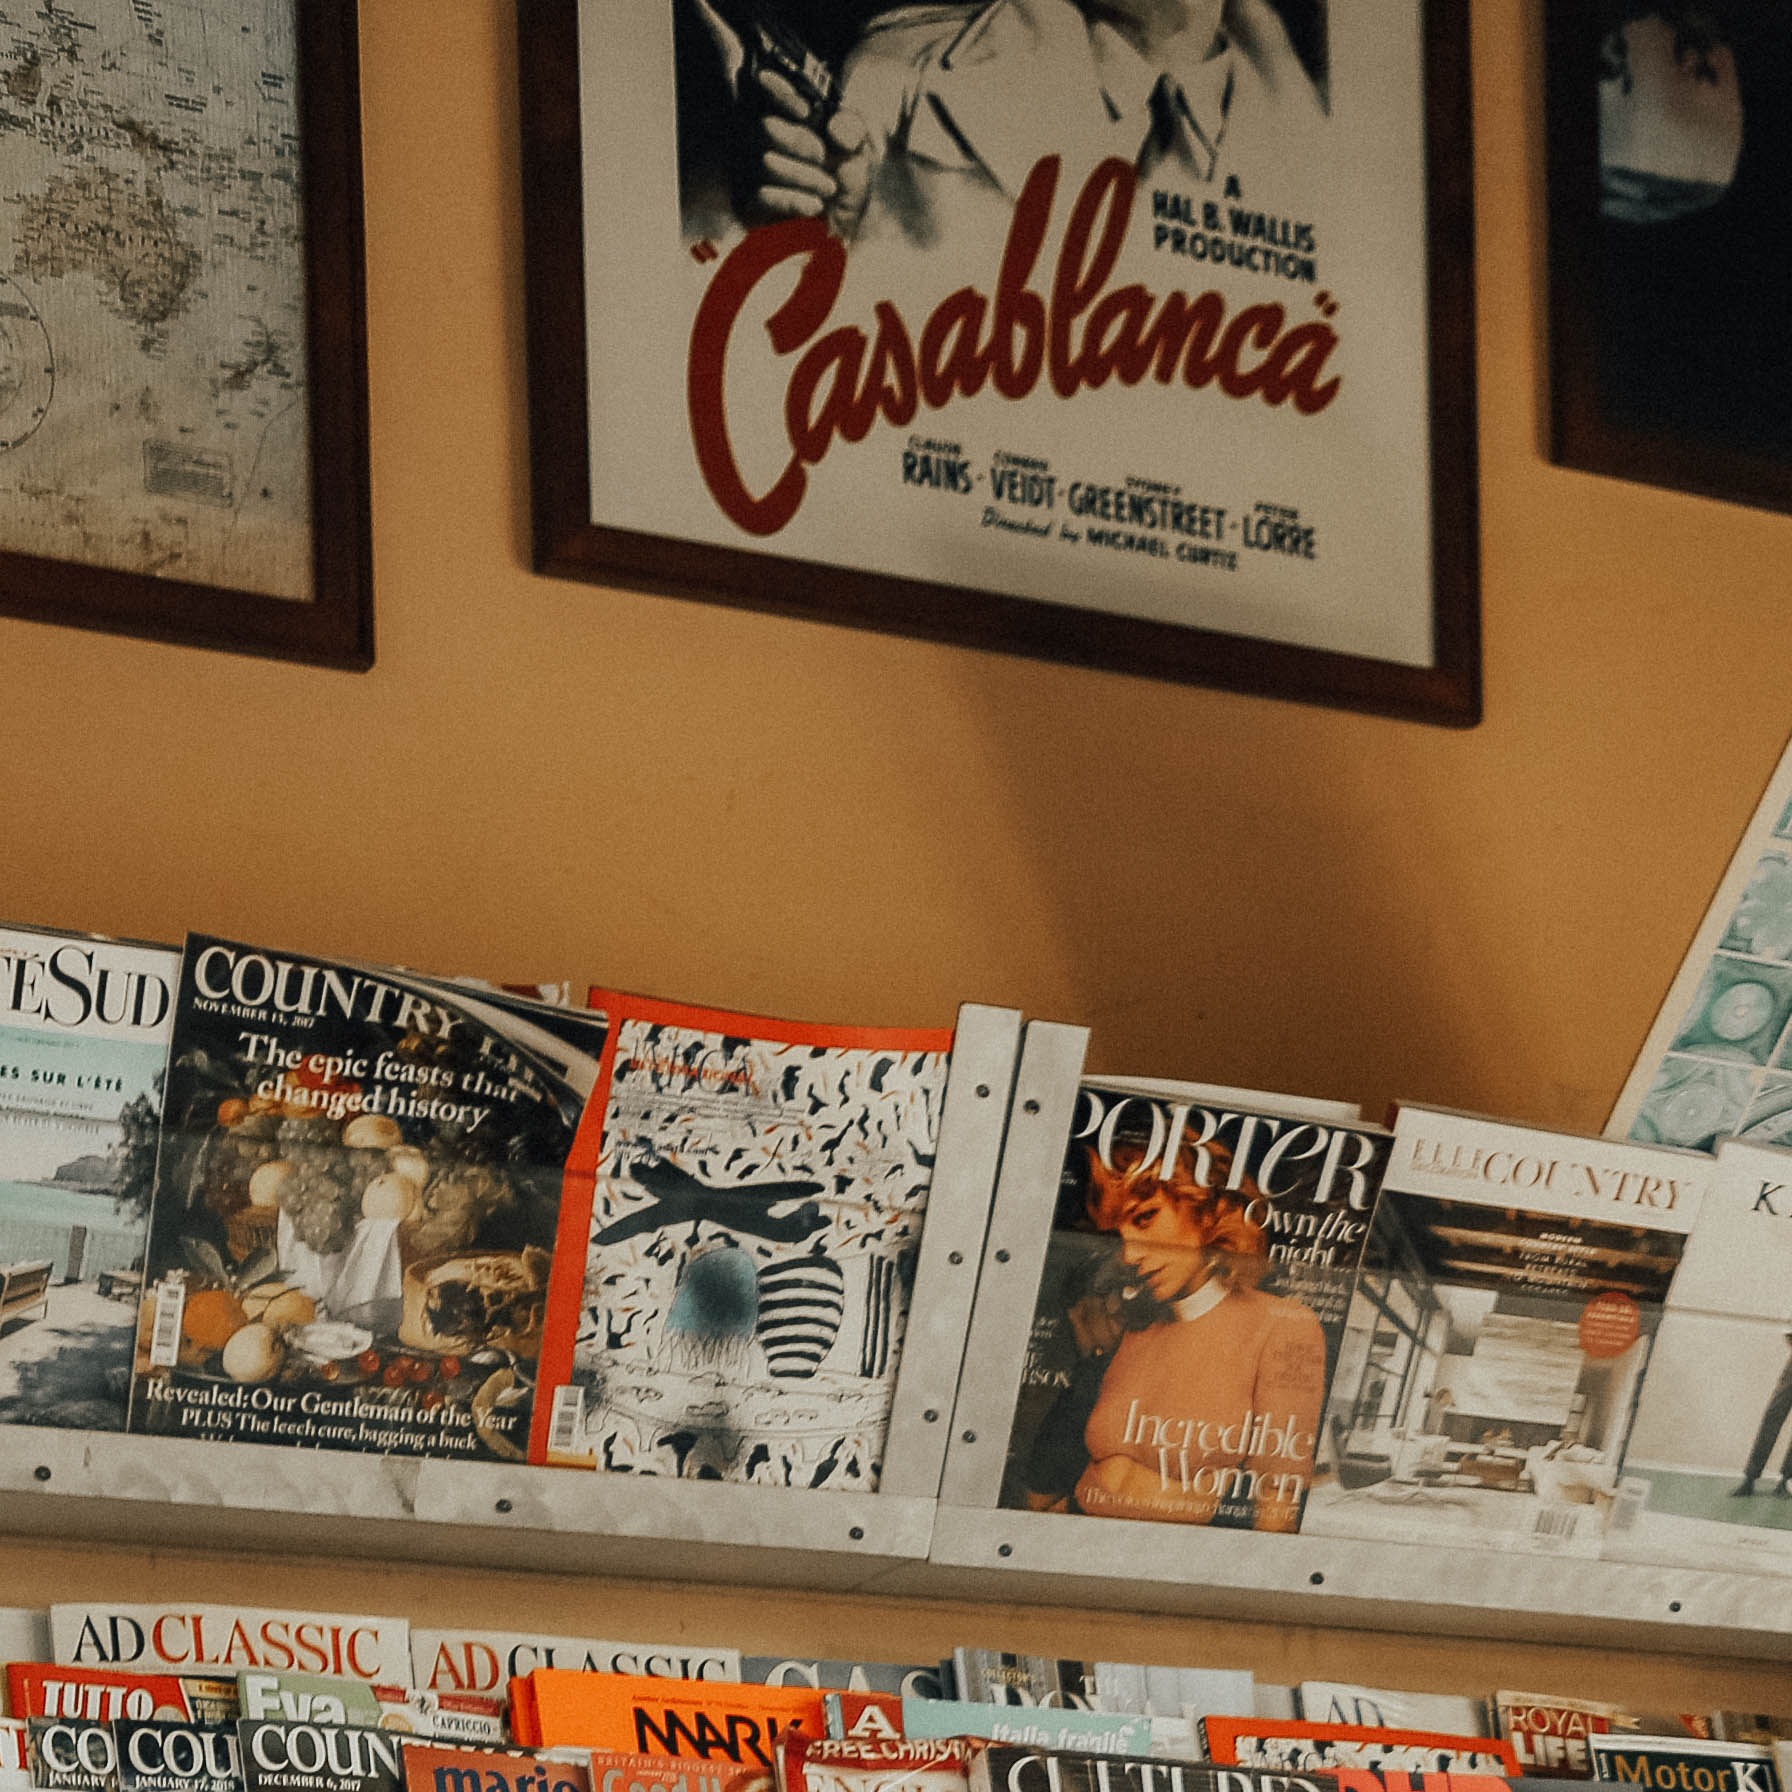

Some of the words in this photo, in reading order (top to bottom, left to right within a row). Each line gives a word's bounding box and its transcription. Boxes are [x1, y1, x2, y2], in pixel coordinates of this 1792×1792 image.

[1224, 174, 1241, 198] A
[1153, 190, 1196, 226] HAL
[1229, 208, 1315, 252] WALLIS
[1155, 223, 1317, 284] PRODUCTION
[903, 451, 973, 494] RAINS
[990, 468, 1056, 509] VEIDT
[1068, 482, 1226, 540] GREENSTREET
[1243, 516, 1316, 559] LORRE
[192, 997, 267, 1021] NOVEMBER
[195, 946, 465, 1039] COUNTRY
[31, 1069, 66, 1084] SUR
[239, 1031, 302, 1067] The
[308, 1050, 368, 1084] epic
[374, 1048, 453, 1087] feasts
[462, 1072, 518, 1102] that
[257, 1074, 389, 1121] changed
[388, 1085, 490, 1133] history
[1484, 1151, 1694, 1210] COUNTRY
[1244, 1198, 1322, 1237] Own
[1317, 1209, 1367, 1243] the
[1269, 1239, 1336, 1266] night
[147, 1378, 249, 1409] Revealed:
[251, 1388, 296, 1412] Our
[300, 1391, 413, 1423] Gentleman
[416, 1409, 438, 1425] of
[439, 1408, 472, 1427] the
[475, 1413, 518, 1431] Year
[181, 1408, 232, 1429] PLUS
[235, 1412, 270, 1433] The
[272, 1416, 317, 1437] leech
[359, 1424, 425, 1450] bagging
[426, 1433, 436, 1446] a
[438, 1435, 478, 1449] buck
[1122, 1400, 1314, 1461] Incredible
[1158, 1447, 1303, 1503] Women
[72, 1614, 145, 1663] AD
[152, 1614, 381, 1678] CLASSIC
[429, 1641, 498, 1691] AD
[42, 1680, 153, 1720] TUTTO
[432, 1715, 490, 1734] CAPRICCIO
[1512, 1732, 1589, 1770] LIFE
[50, 1773, 108, 1788] JANUARY
[135, 1775, 195, 1790] JANUARY
[258, 1773, 323, 1789] DECEMBER
[340, 1778, 361, 1791] 2017
